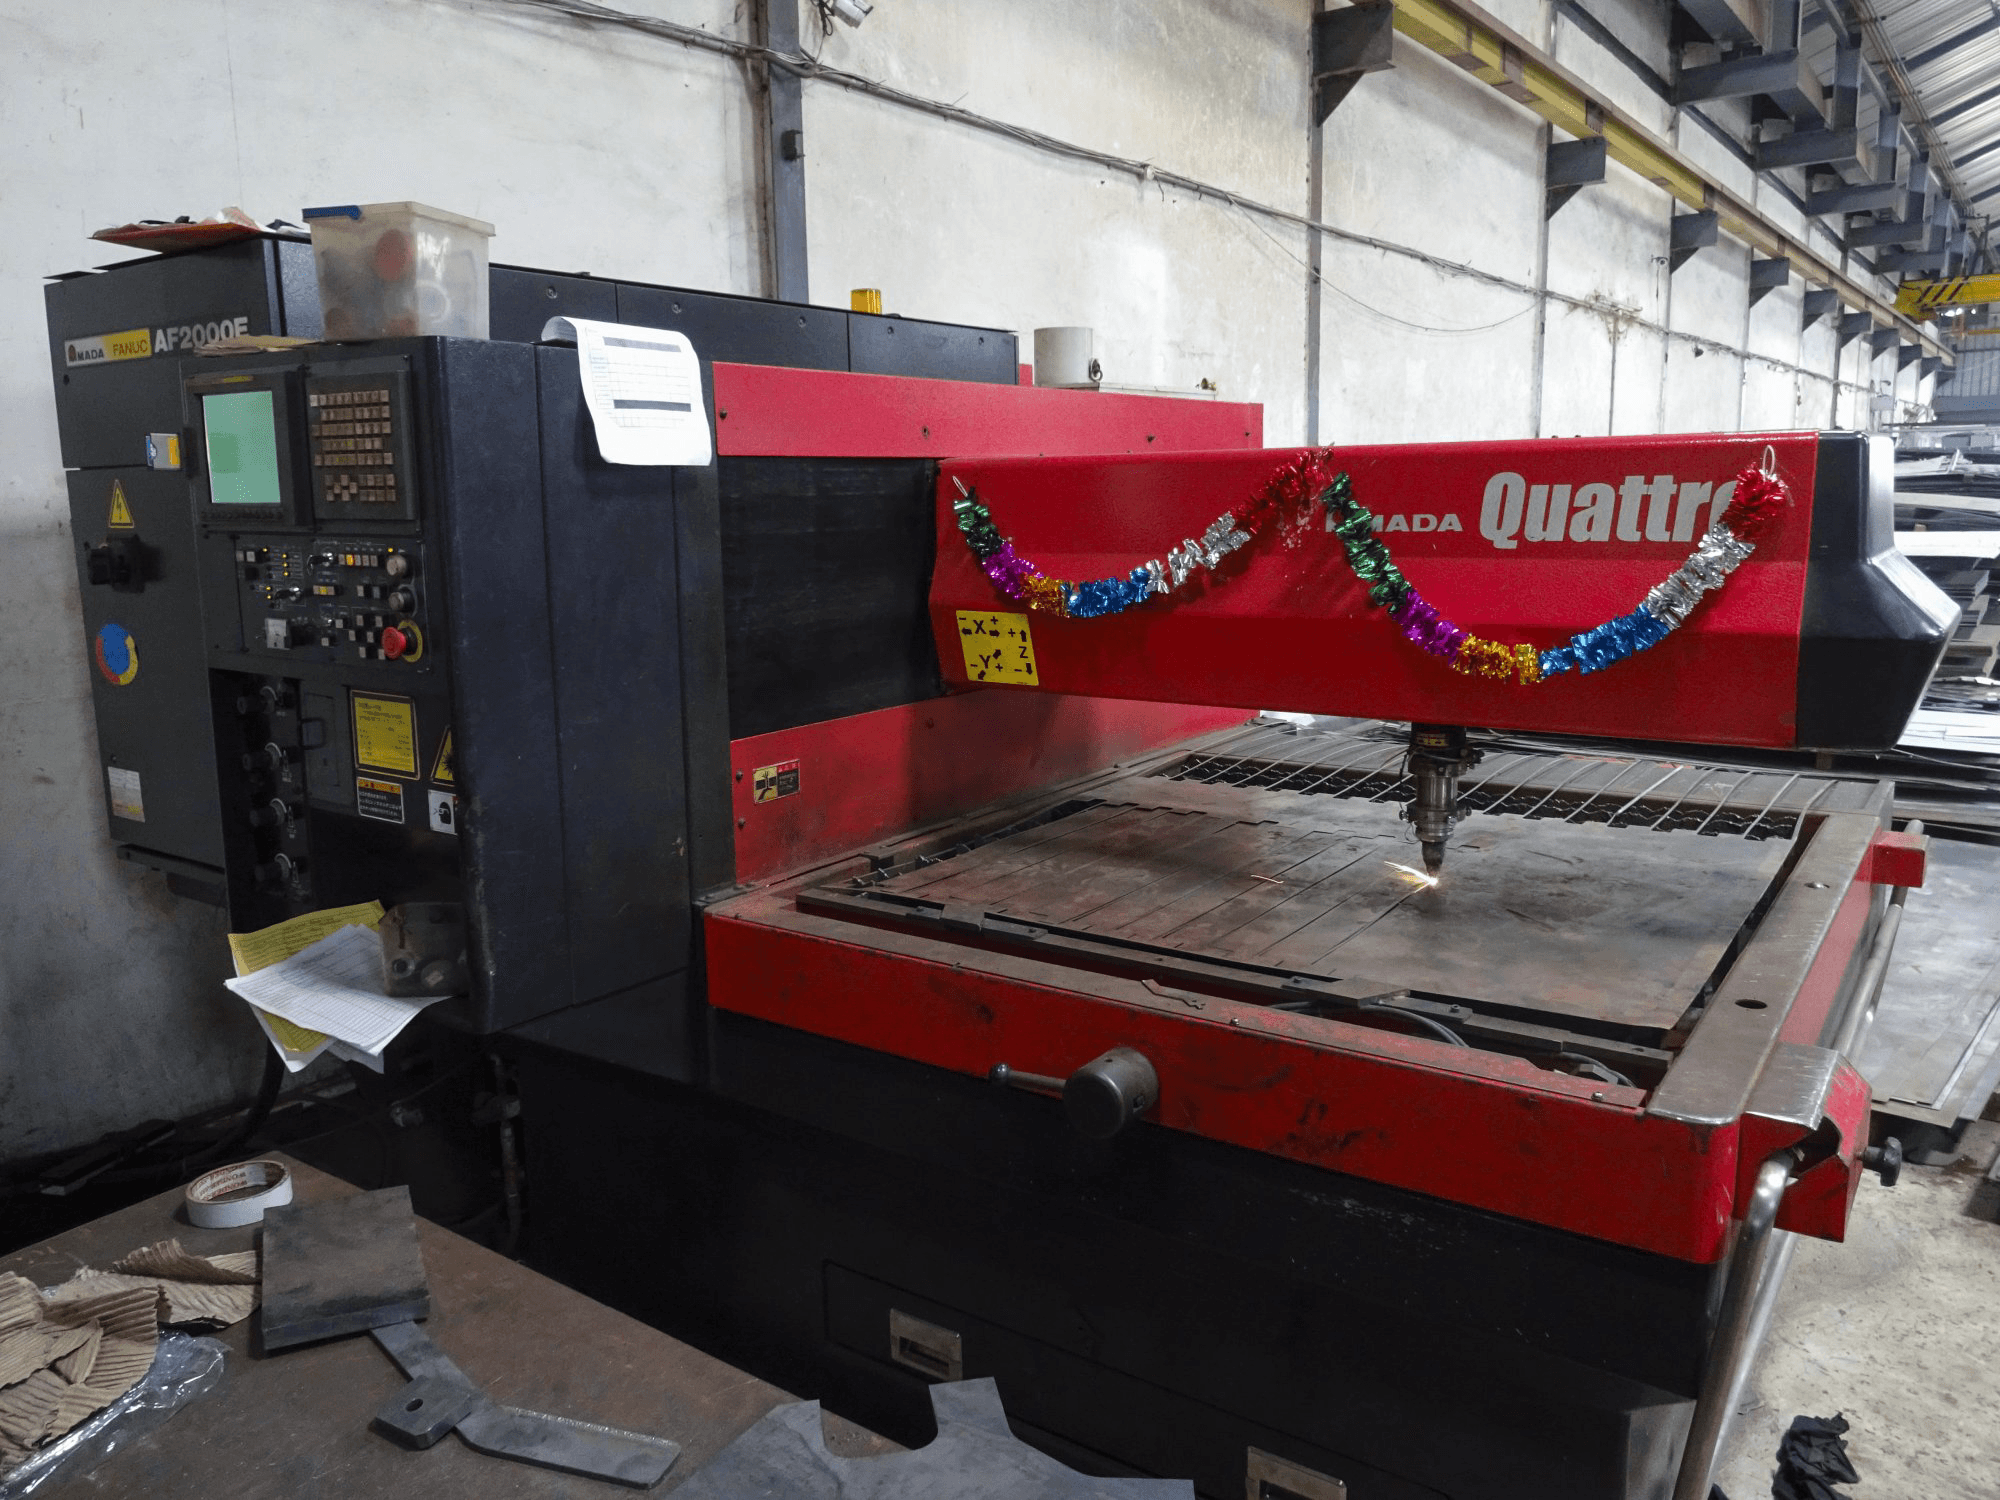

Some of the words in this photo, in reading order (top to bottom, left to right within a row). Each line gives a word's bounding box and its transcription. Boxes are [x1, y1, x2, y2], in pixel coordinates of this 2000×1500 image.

[113, 340, 148, 356] FANUC
[973, 620, 987, 634] X
[1018, 646, 1028, 658] Z
[979, 655, 991, 669] Y
